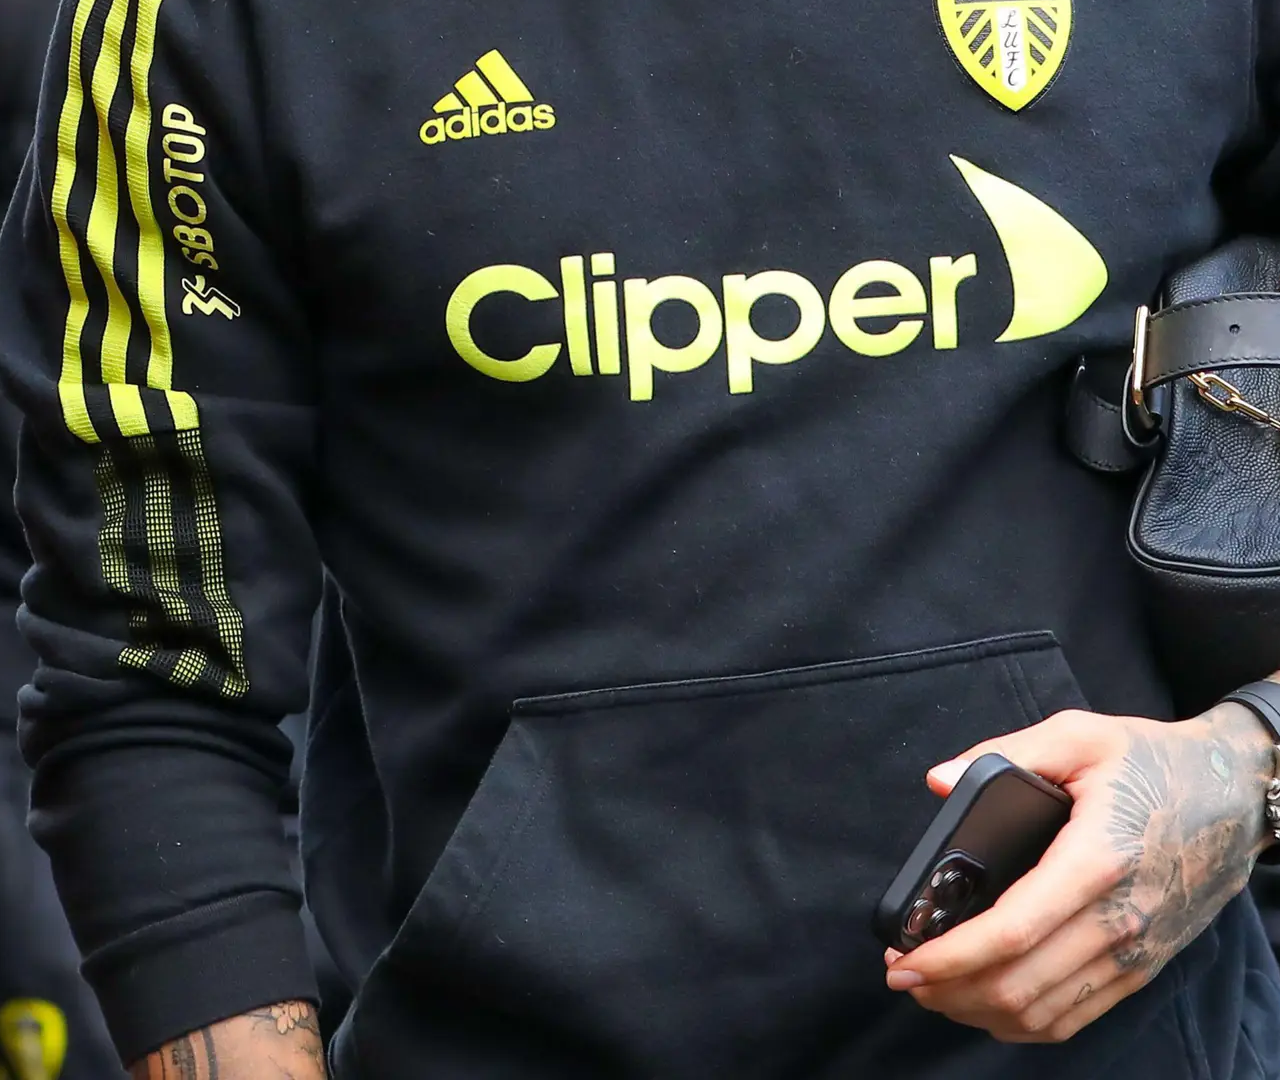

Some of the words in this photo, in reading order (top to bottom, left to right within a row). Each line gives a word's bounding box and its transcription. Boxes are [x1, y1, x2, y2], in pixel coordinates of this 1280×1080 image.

[1001, 9, 1020, 86] LUFC
[419, 101, 556, 145] adidas
[162, 103, 219, 270] SBOTOP
[445, 252, 978, 401] Clipper
